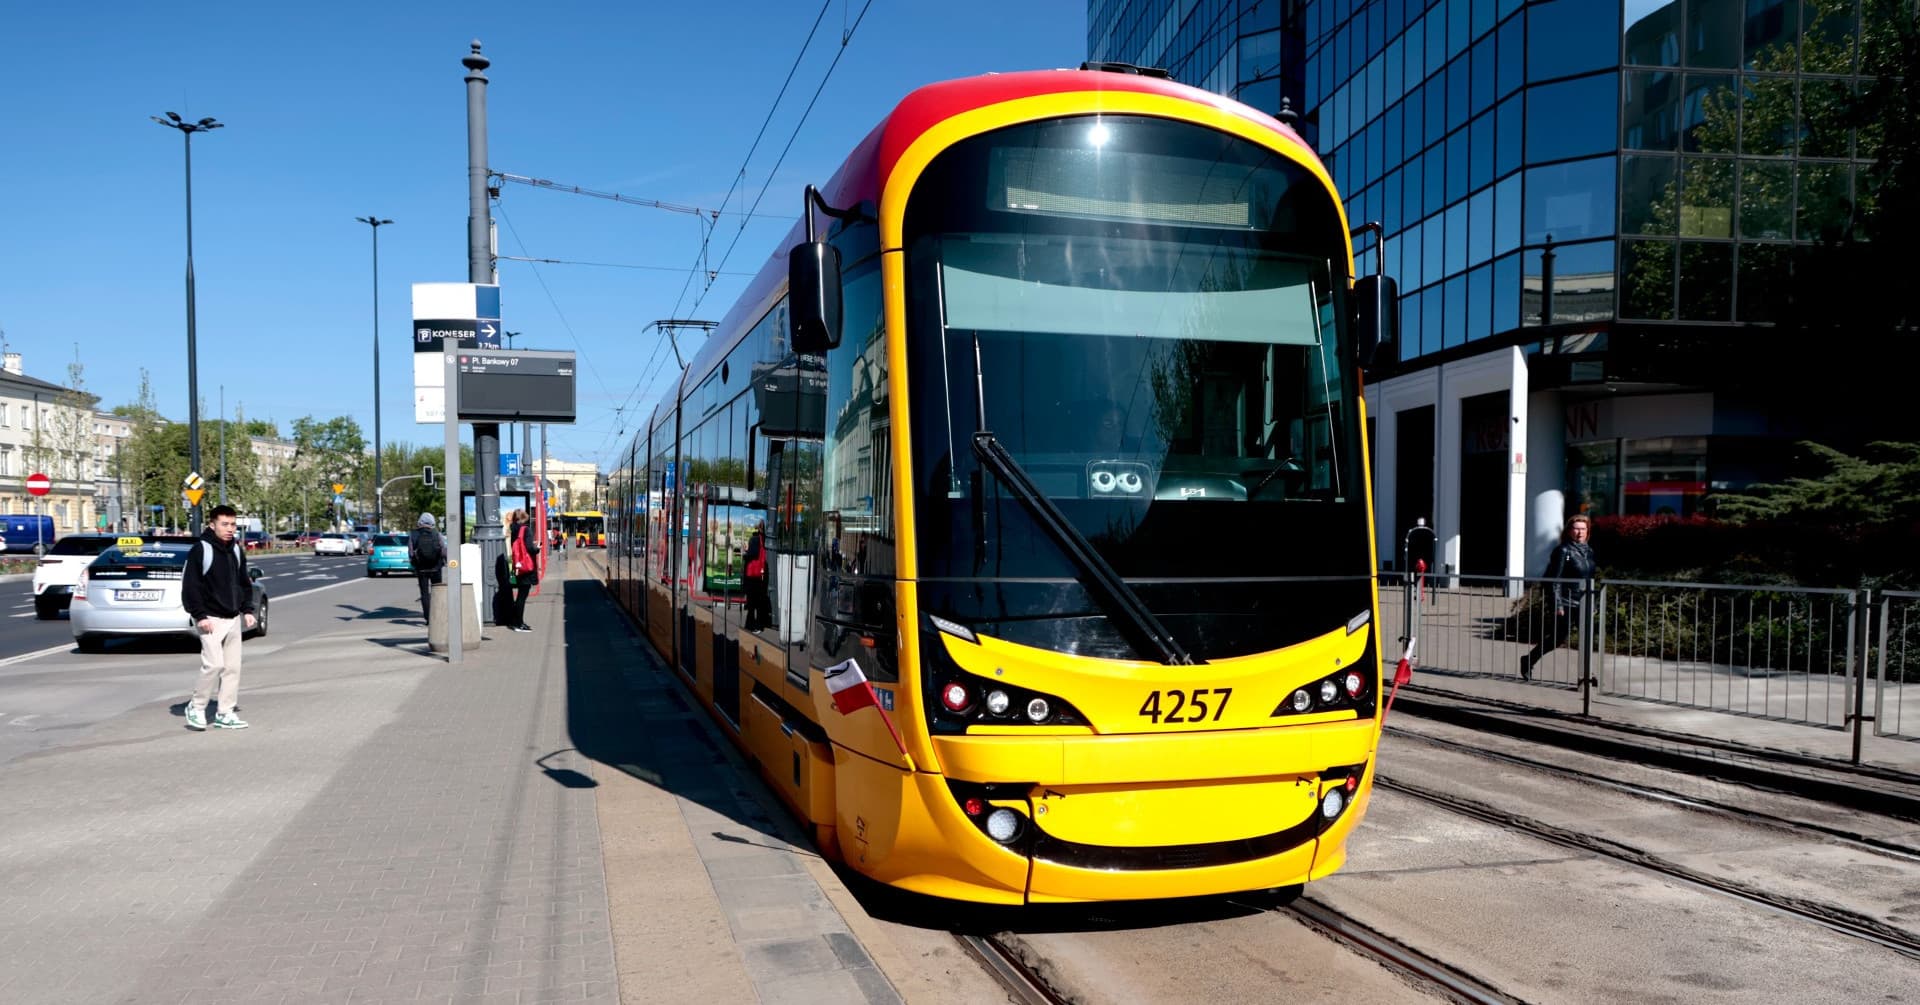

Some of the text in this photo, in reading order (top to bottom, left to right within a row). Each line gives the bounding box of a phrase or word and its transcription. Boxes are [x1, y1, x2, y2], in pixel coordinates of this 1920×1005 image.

[432, 330, 476, 338] KONESER
[481, 357, 509, 367] Bankowy
[510, 358, 519, 366] 07
[1138, 688, 1233, 724] 4257
